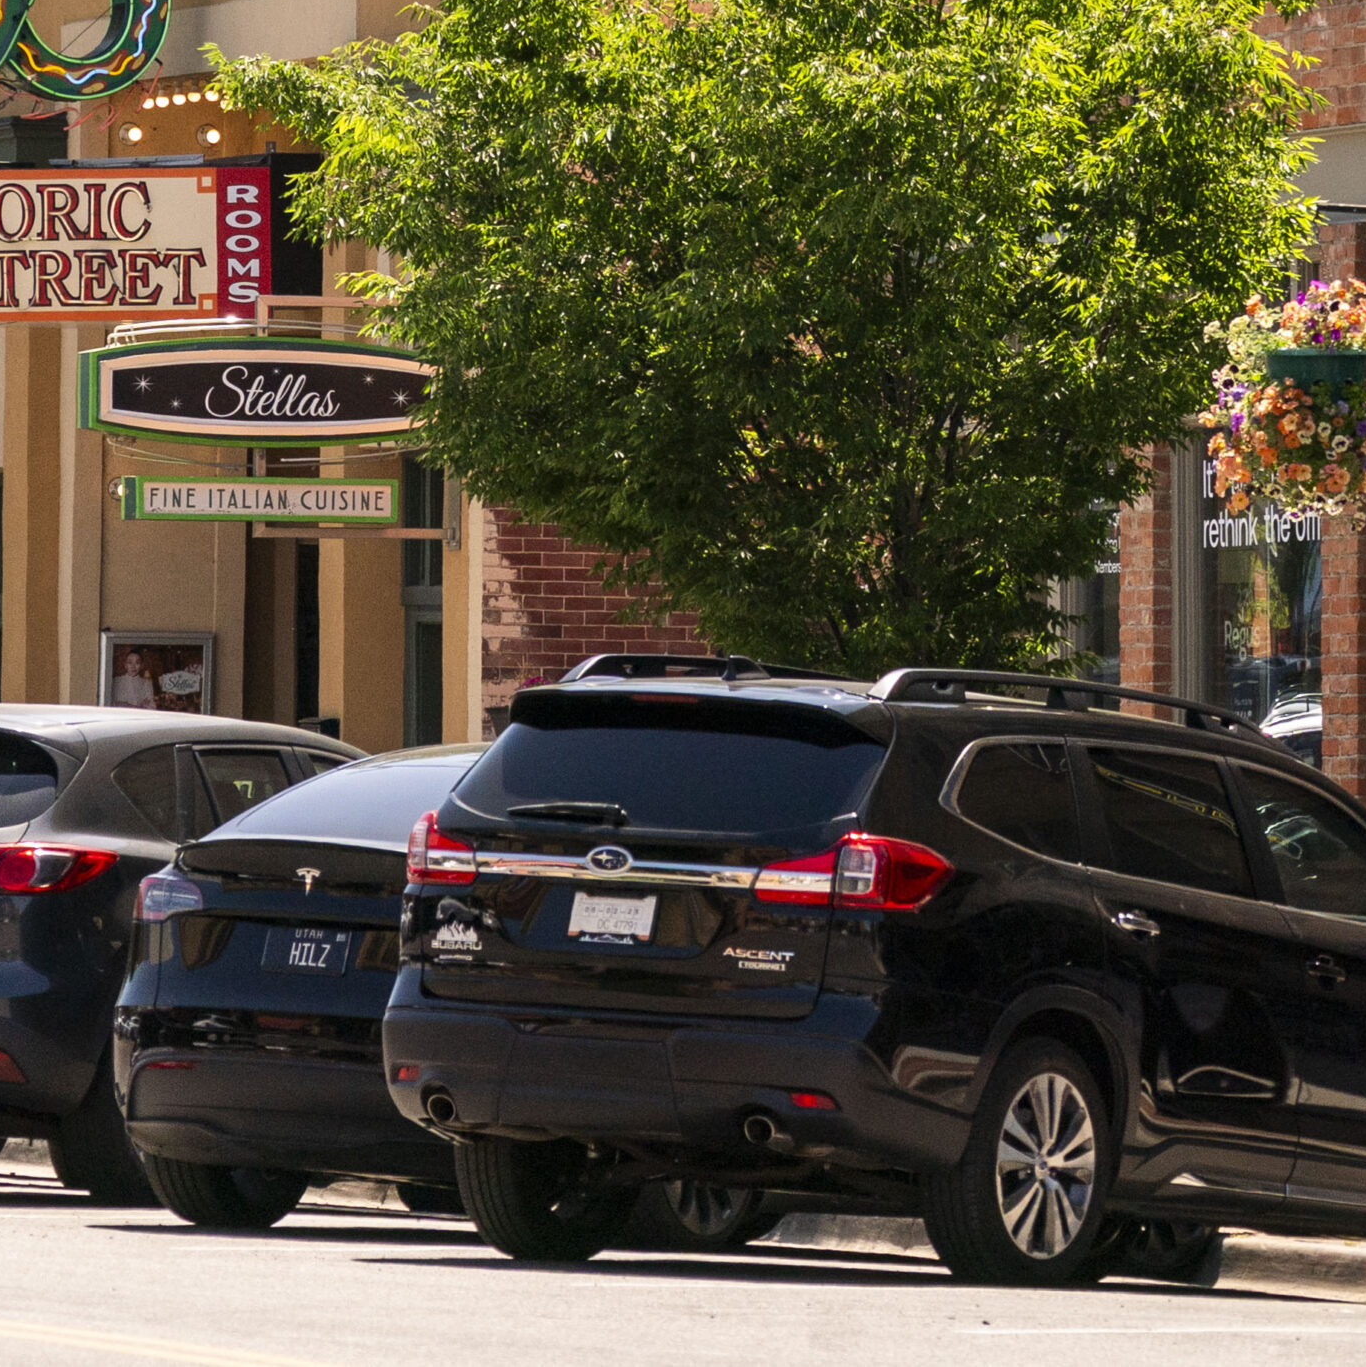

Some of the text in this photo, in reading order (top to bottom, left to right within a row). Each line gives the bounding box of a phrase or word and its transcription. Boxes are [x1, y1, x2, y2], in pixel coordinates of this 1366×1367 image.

[225, 184, 262, 304] ROOMS
[205, 365, 341, 418] Stellas
[149, 487, 385, 511] FINE ITALIAN CUISINE
[1203, 505, 1258, 549] rethink
[1264, 504, 1291, 543] the
[295, 928, 324, 939] UTAH
[430, 939, 483, 951] SUBARU
[288, 941, 331, 968] HILZ
[722, 946, 795, 962] ASCENT
